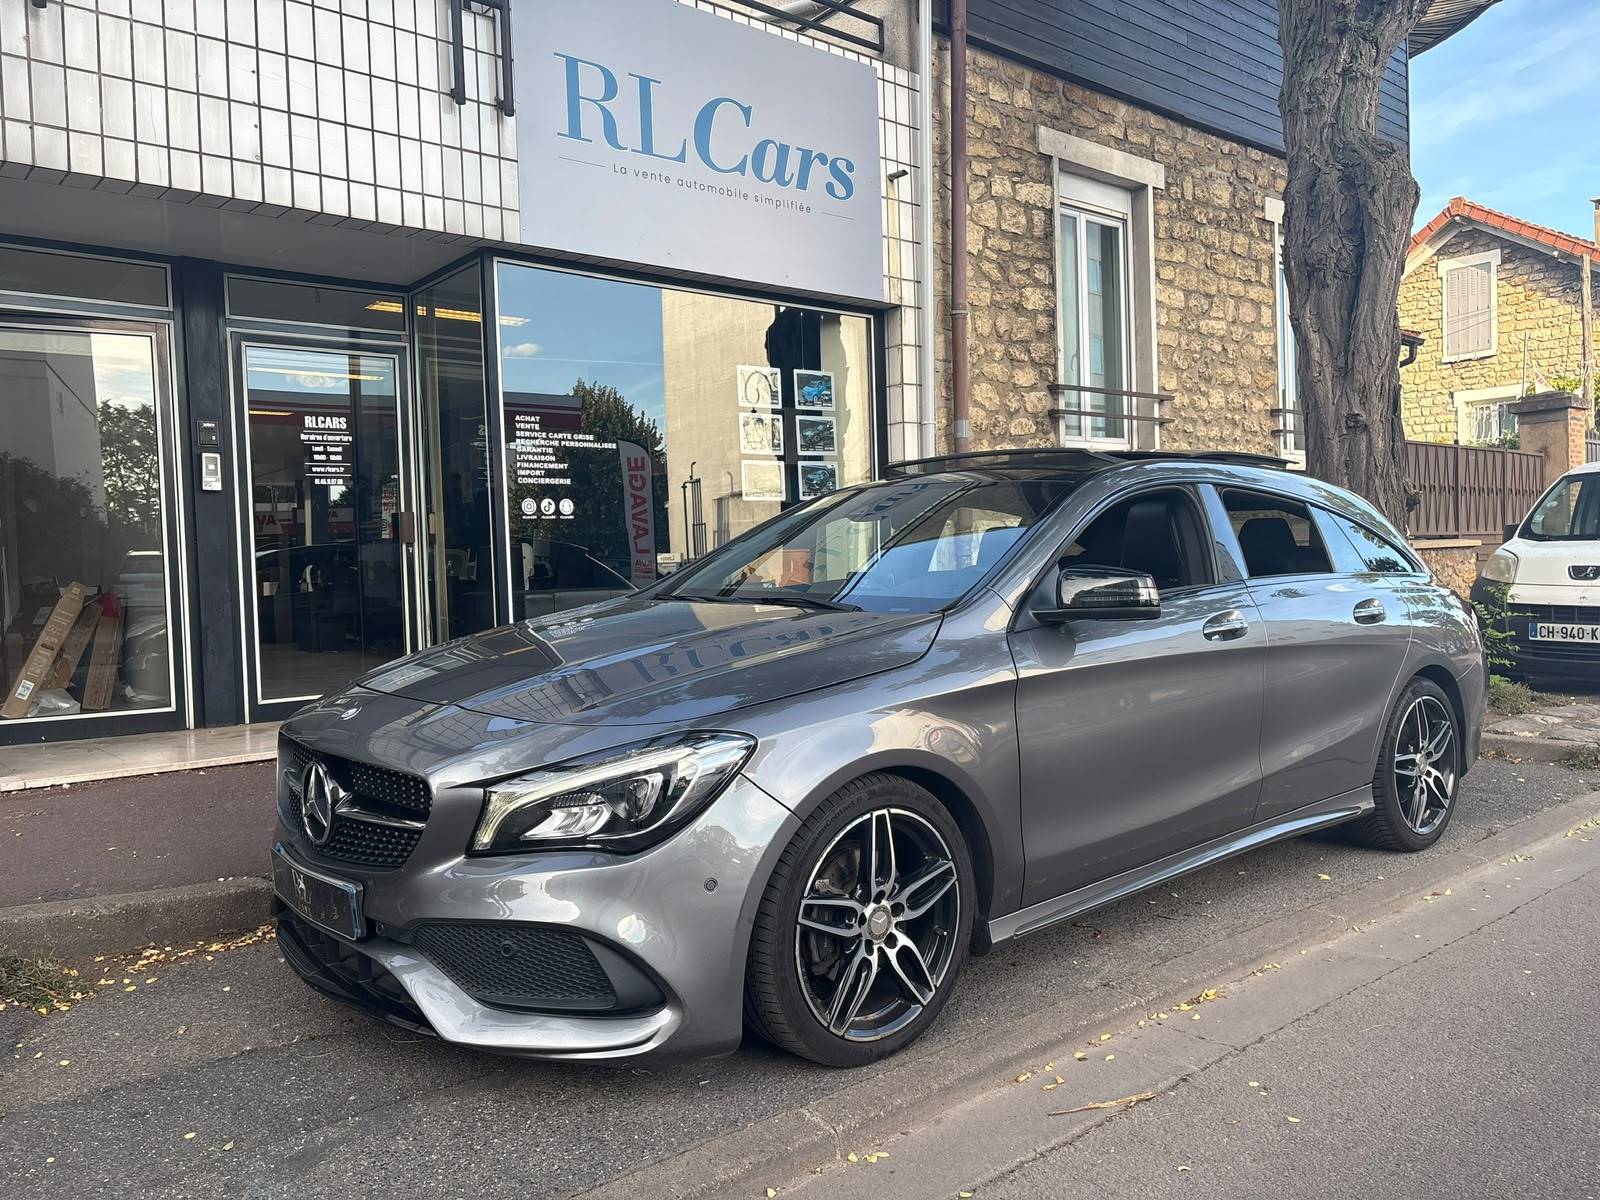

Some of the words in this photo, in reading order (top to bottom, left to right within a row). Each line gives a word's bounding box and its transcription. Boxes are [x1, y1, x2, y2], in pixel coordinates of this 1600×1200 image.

[553, 52, 856, 201] RLCars
[613, 163, 627, 175] La
[634, 168, 671, 184] vente
[677, 178, 749, 201] automobile
[754, 193, 812, 214] simplifiée
[304, 415, 347, 429] RLCARS
[515, 414, 540, 422] ACHAT
[515, 422, 540, 430] VENTE
[548, 432, 572, 440] CARTE
[516, 438, 559, 447] RECHERCHE
[516, 446, 553, 454] GARANTIE
[516, 454, 556, 462] LIVRAISON
[516, 462, 568, 470] FINANCEMENT
[517, 477, 572, 485] CONCIERGERIE
[1539, 625, 1599, 640] CH-940-K
